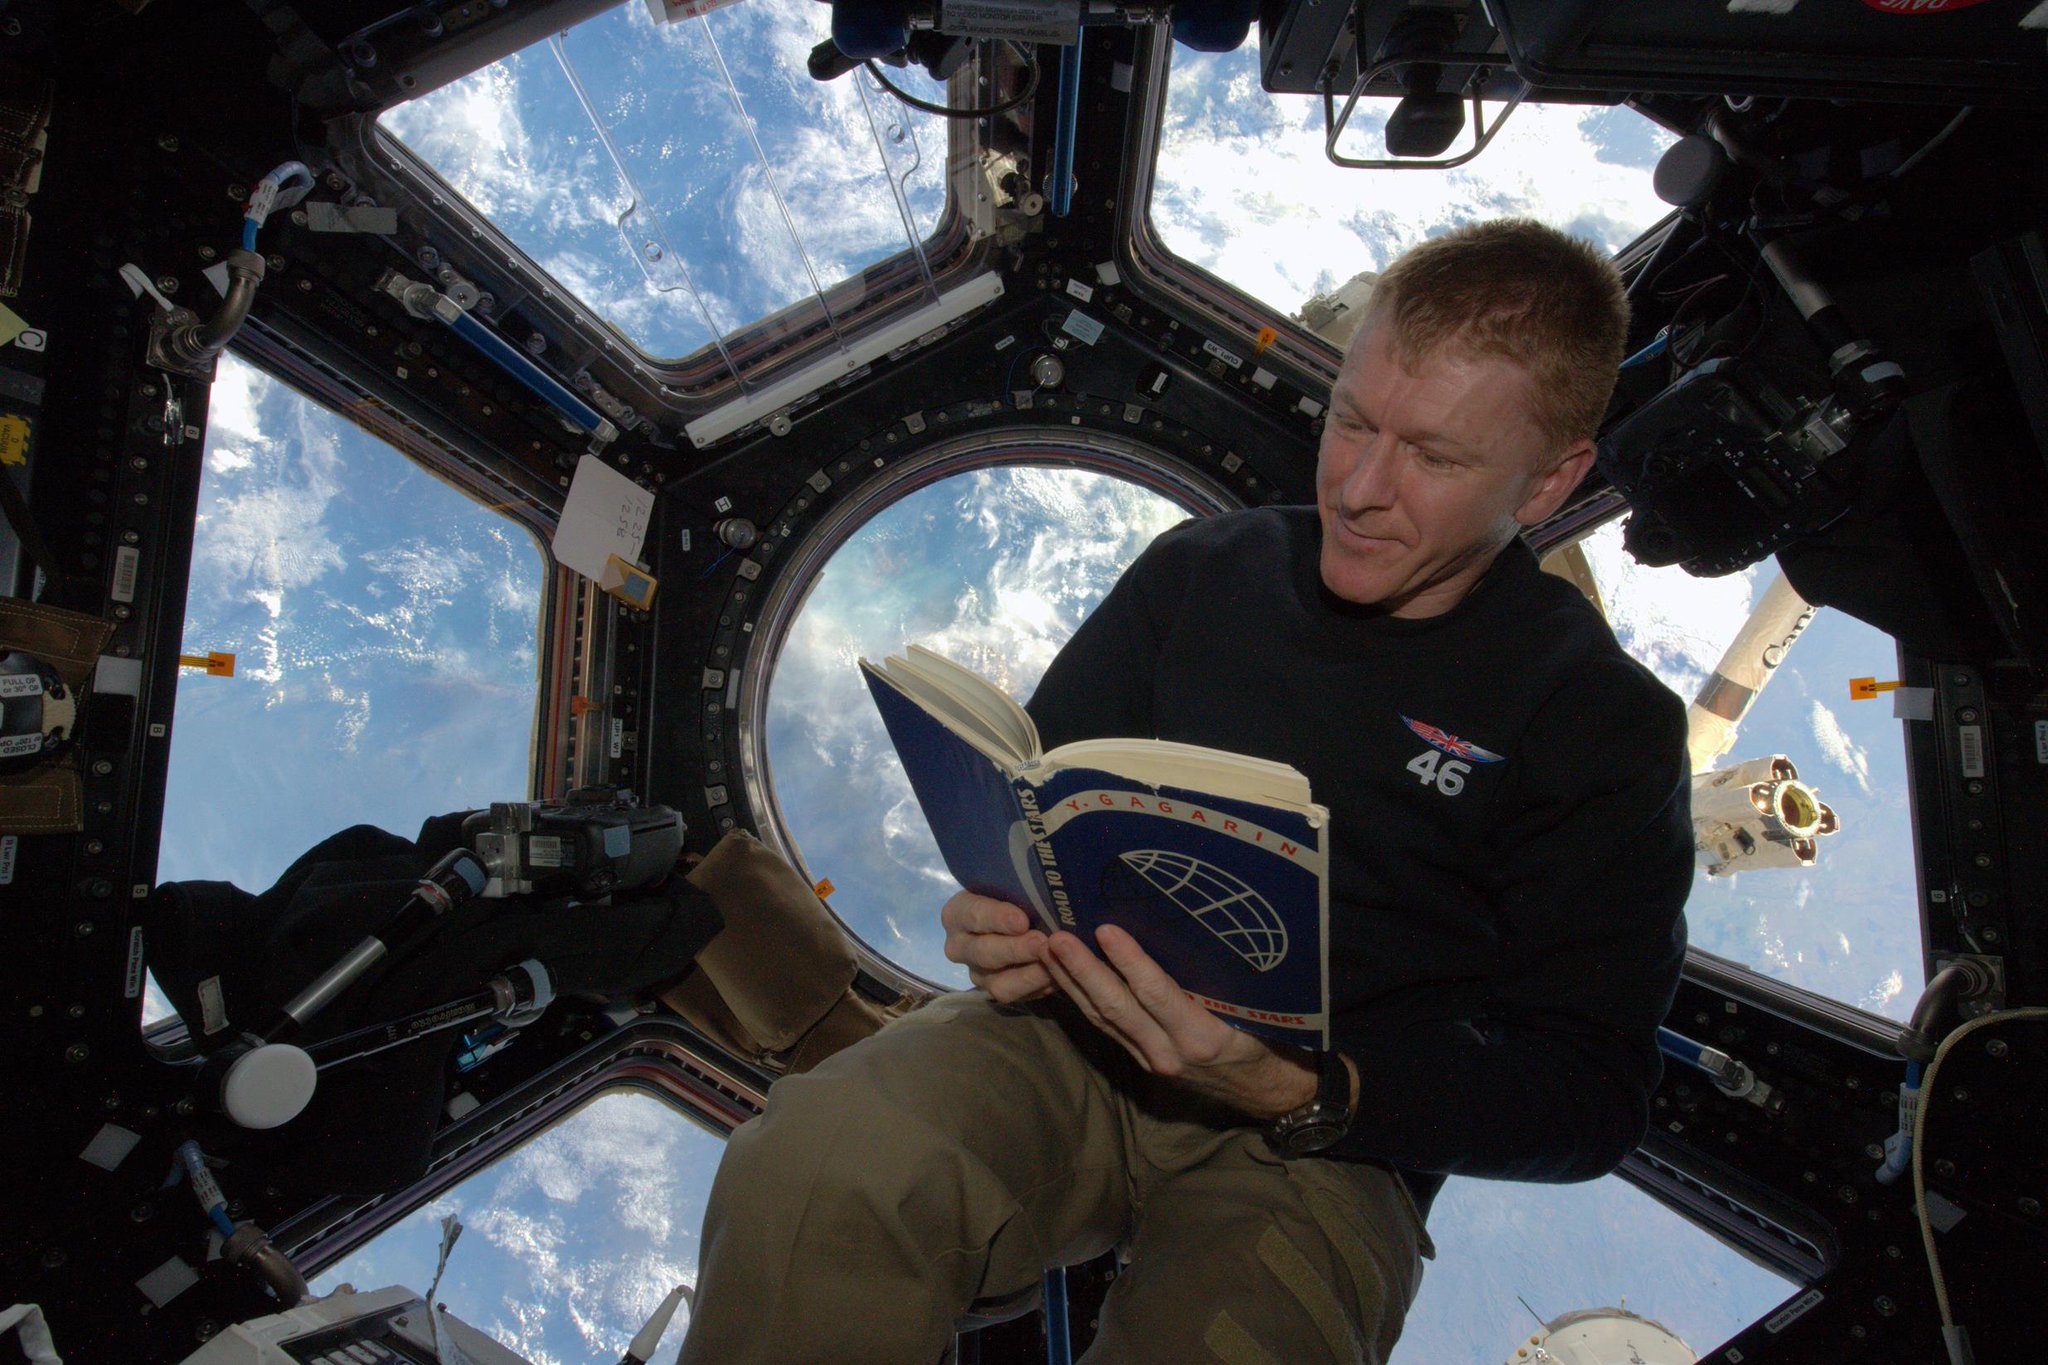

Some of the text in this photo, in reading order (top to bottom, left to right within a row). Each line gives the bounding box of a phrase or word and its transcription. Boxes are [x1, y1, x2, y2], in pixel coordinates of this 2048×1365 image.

[3, 744, 37, 753] CLOSED
[1406, 749, 1472, 796] 46
[1065, 793, 1298, 857] Y. GAGARIN
[1017, 788, 1076, 926] ROAD TO THE STARS
[1202, 999, 1238, 1014] THE
[1246, 1009, 1306, 1025] STARS
